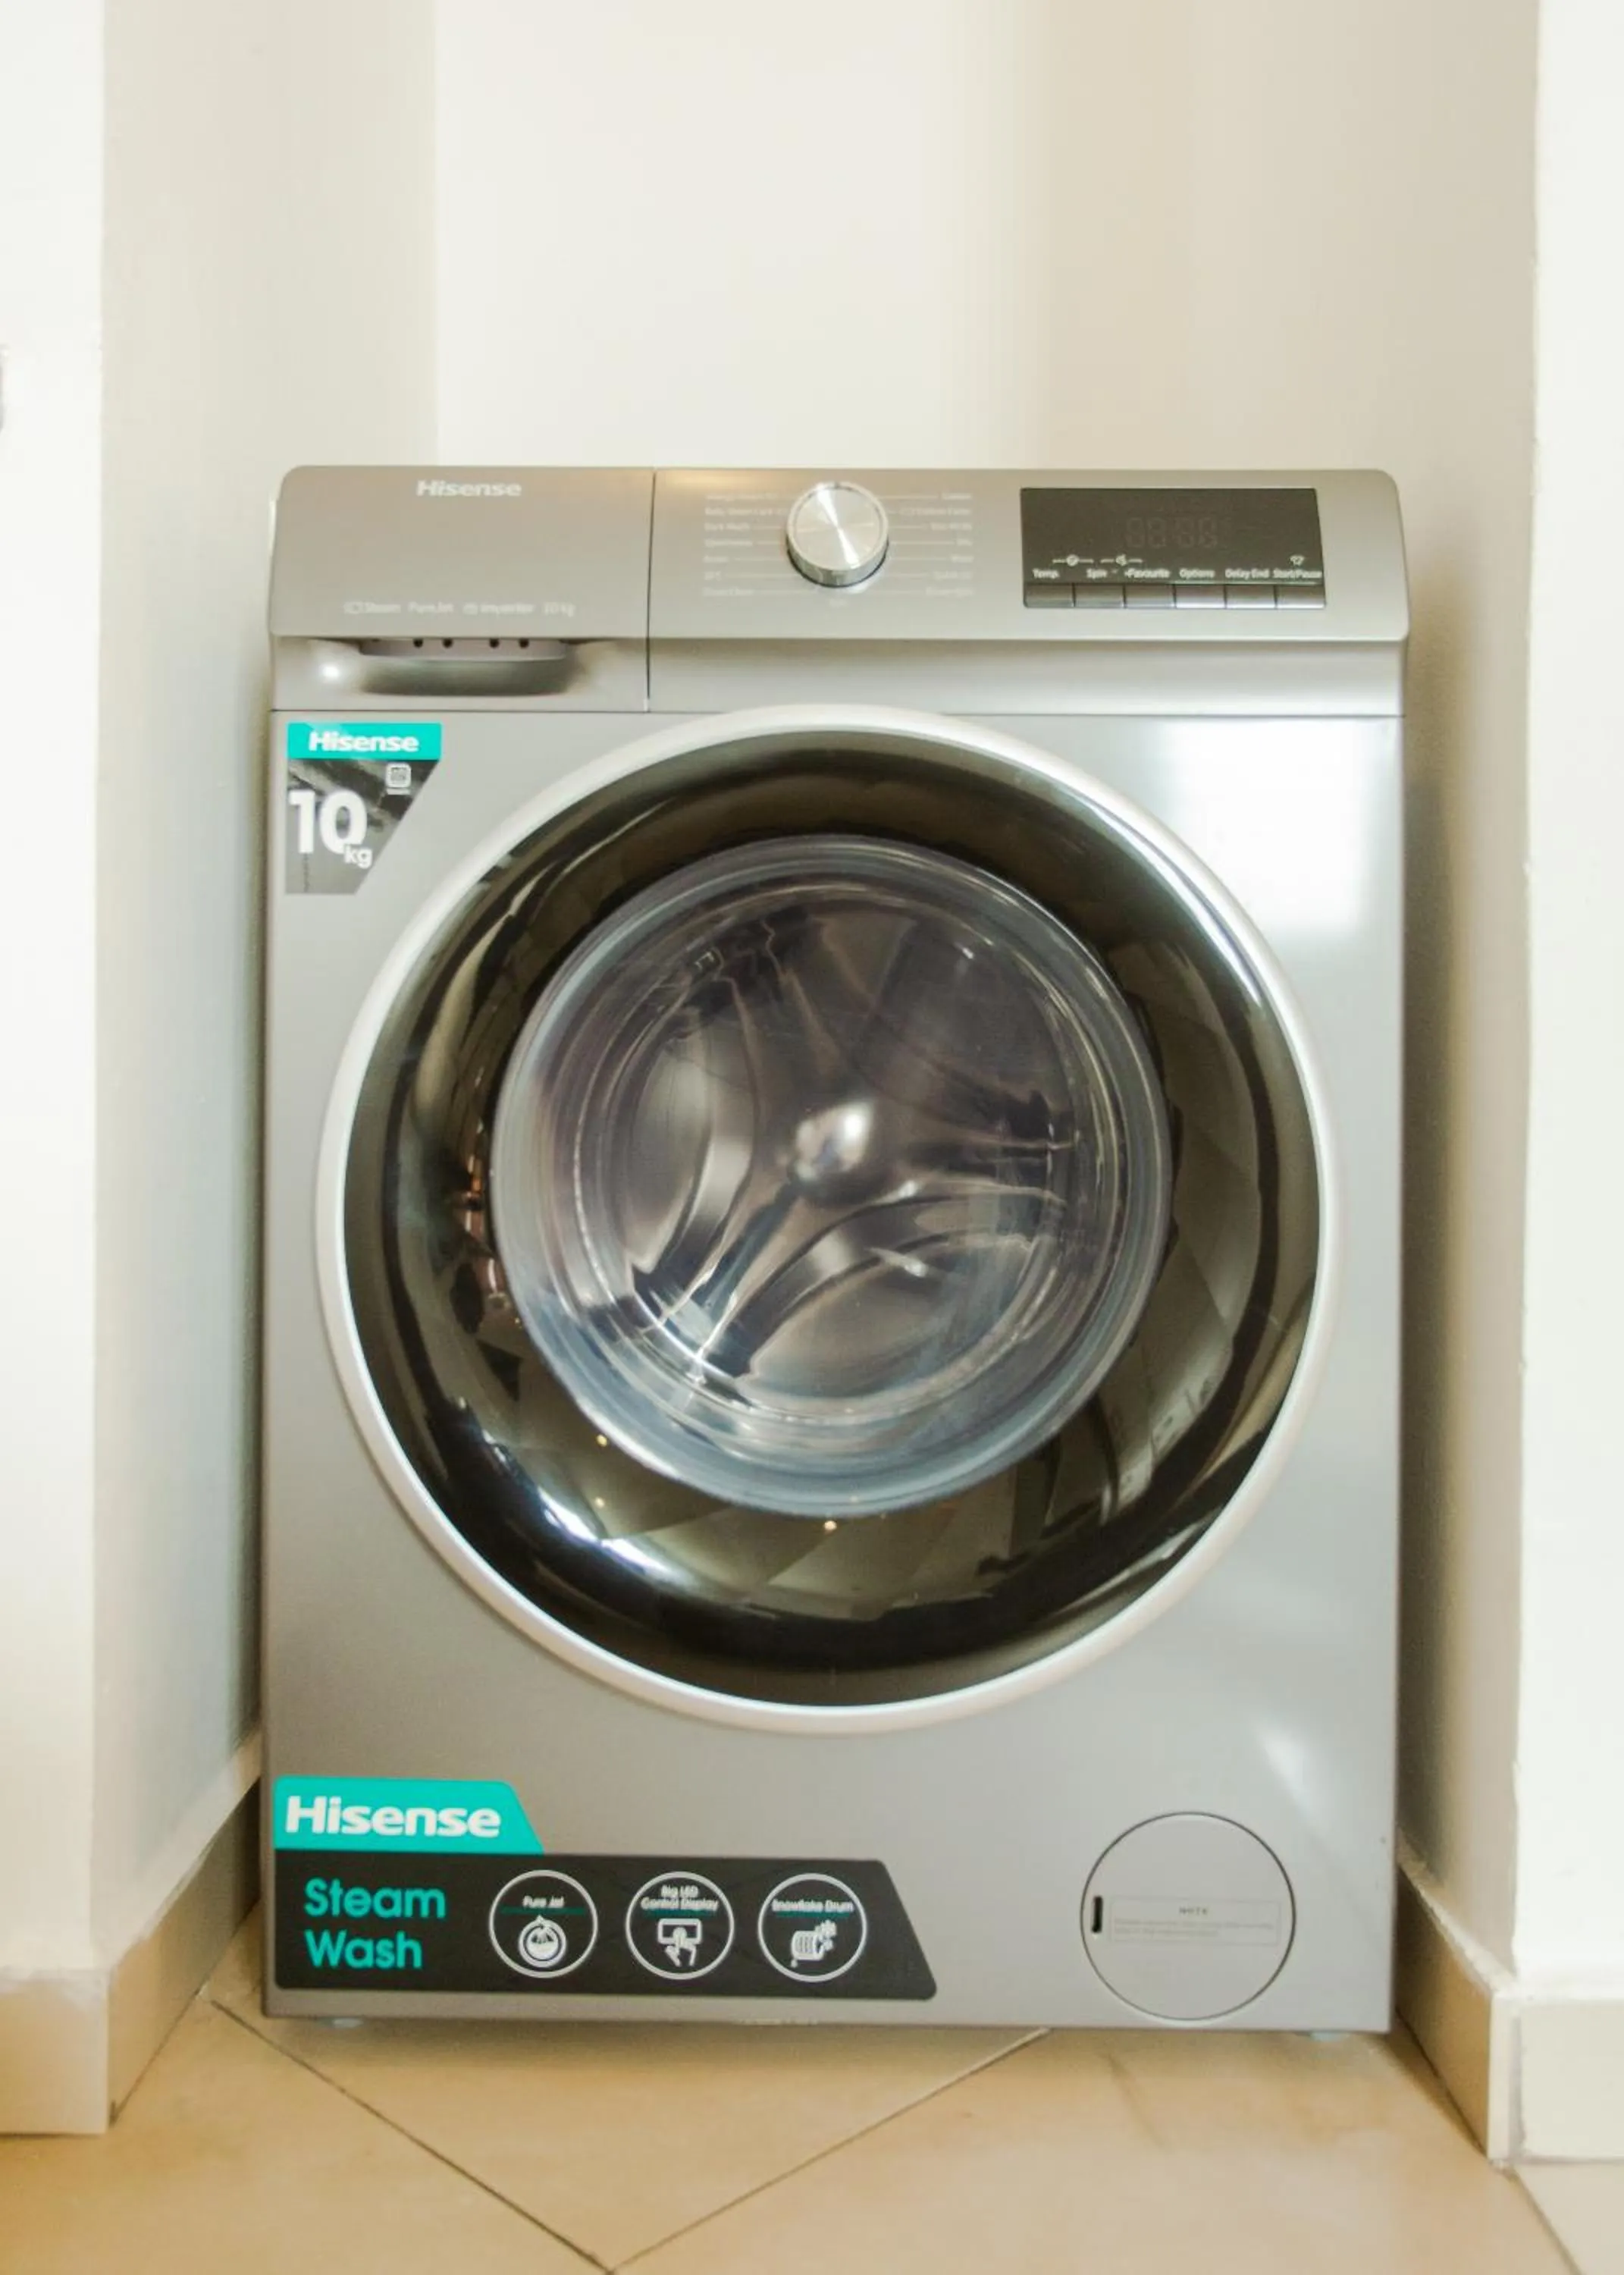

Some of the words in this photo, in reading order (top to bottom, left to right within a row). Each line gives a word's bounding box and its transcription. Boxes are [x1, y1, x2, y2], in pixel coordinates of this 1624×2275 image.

[417, 479, 522, 497] Hisense
[1086, 569, 1107, 579] Spin
[1179, 569, 1215, 579] Options
[1224, 569, 1250, 579] Delay
[1252, 569, 1269, 579] End
[309, 731, 419, 752] Hisense
[289, 789, 368, 855] 10
[343, 845, 372, 869] kg
[285, 1795, 501, 1837] Hisense
[305, 1878, 446, 1918] Steam
[523, 1895, 547, 1908] Pure
[824, 1900, 854, 1913] Drum
[304, 1929, 423, 1969] Wash
